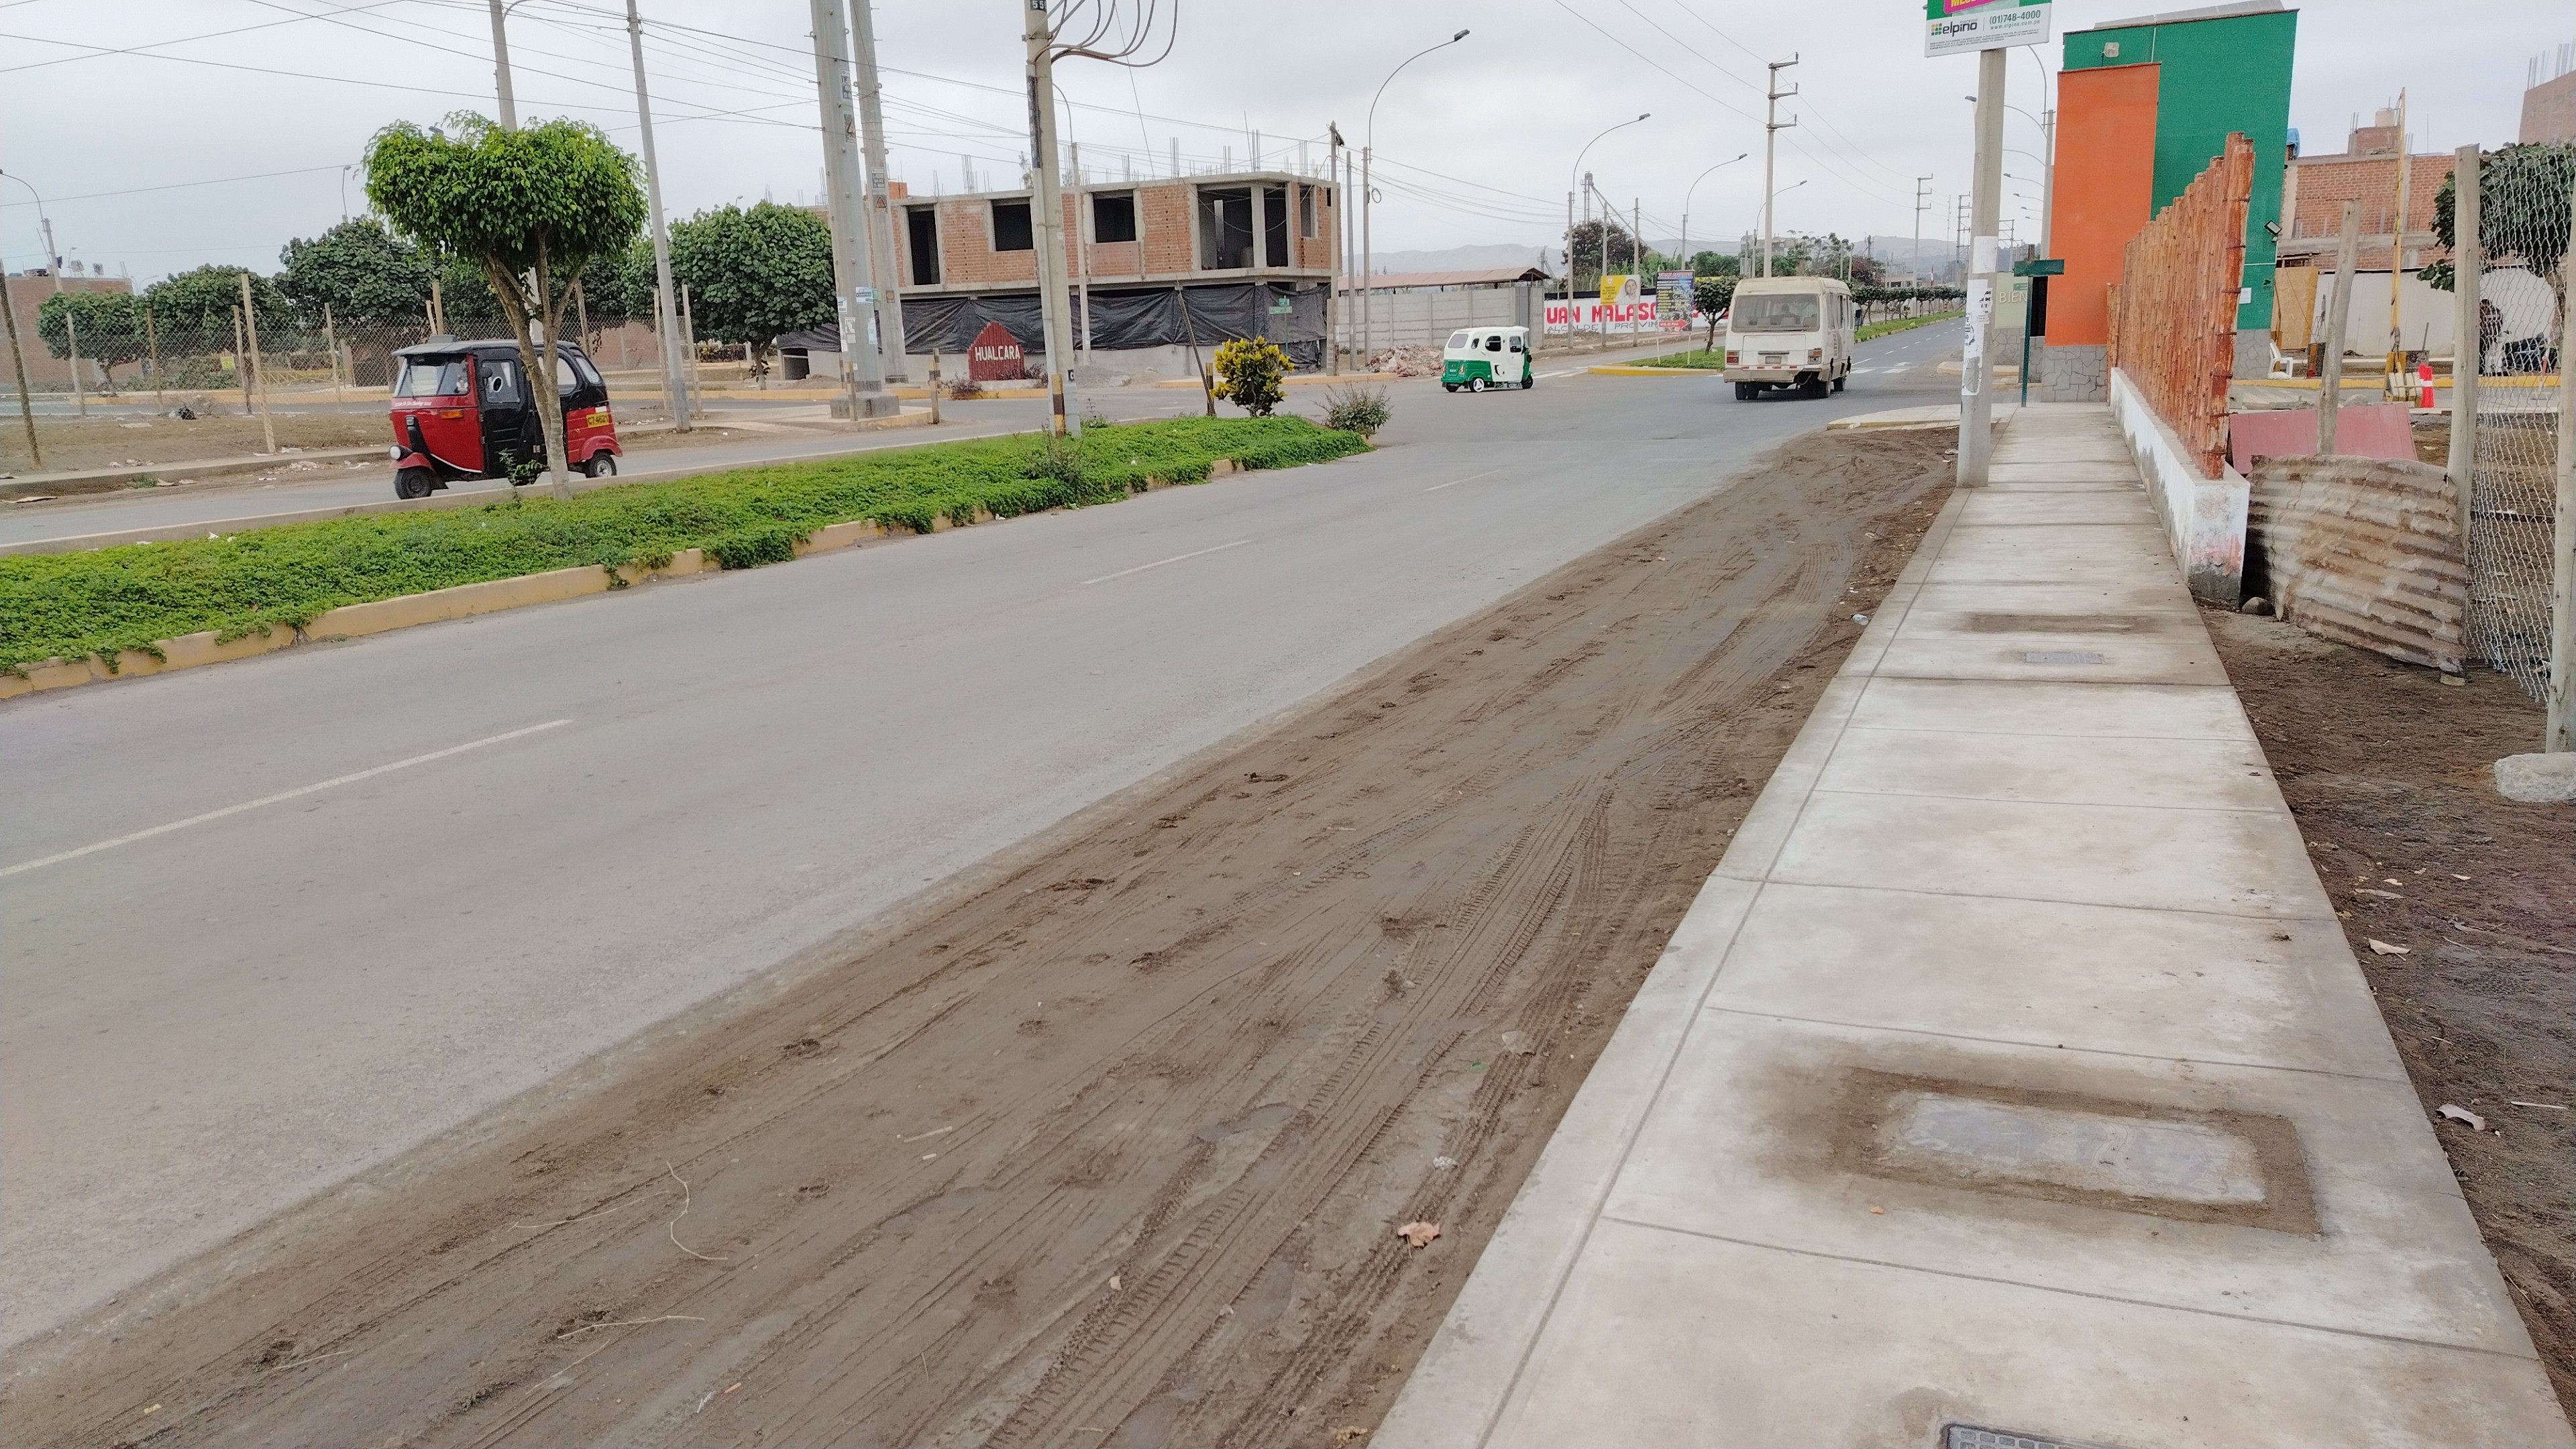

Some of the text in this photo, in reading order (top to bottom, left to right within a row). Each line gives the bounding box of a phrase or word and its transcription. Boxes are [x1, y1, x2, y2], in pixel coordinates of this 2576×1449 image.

[1989, 10, 2041, 25] (01)748-4000
[1943, 21, 1978, 37] elpino
[975, 345, 1020, 362] HUALCARA
